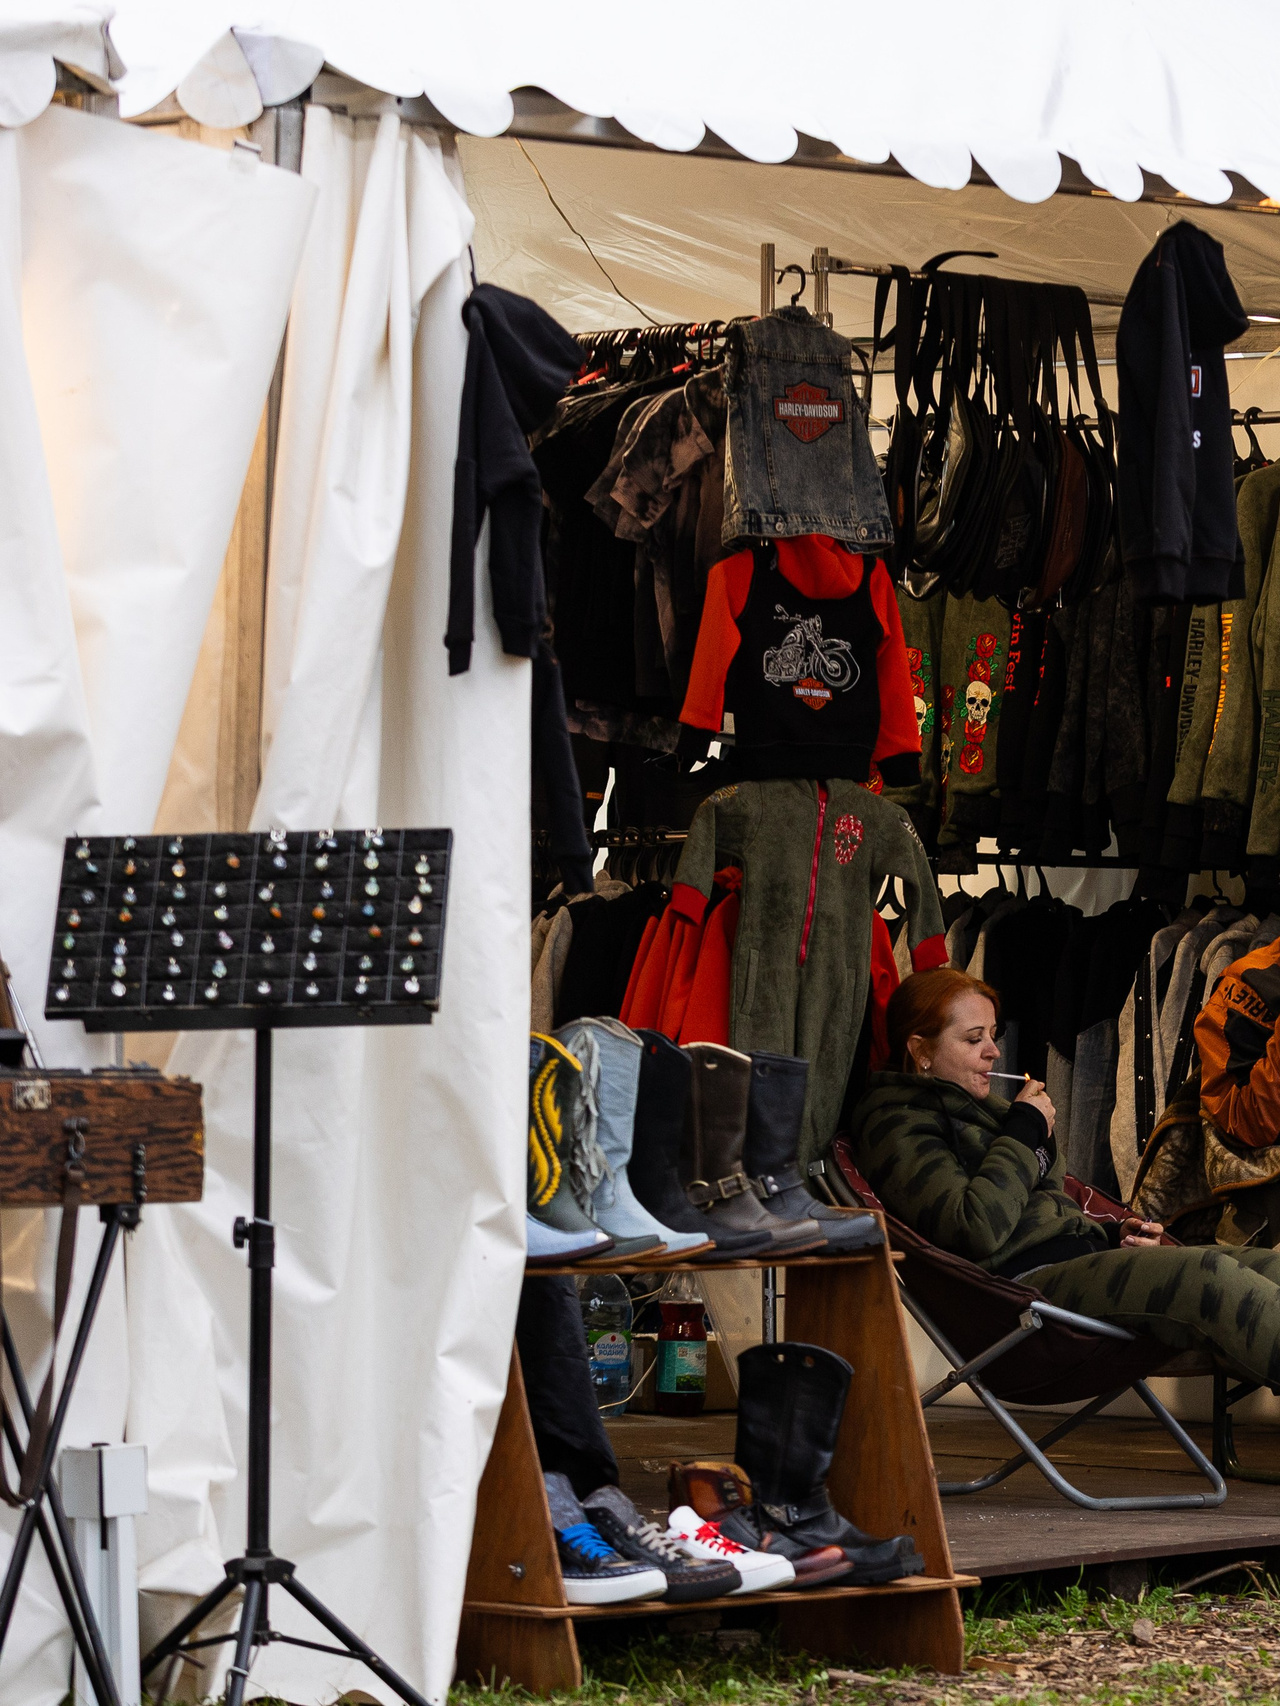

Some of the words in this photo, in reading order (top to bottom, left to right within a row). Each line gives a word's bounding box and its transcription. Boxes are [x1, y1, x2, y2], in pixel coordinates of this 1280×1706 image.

[778, 402, 839, 418] HARLEY-DAVIDSON
[1010, 613, 1024, 645] vin
[1004, 650, 1021, 692] Fest
